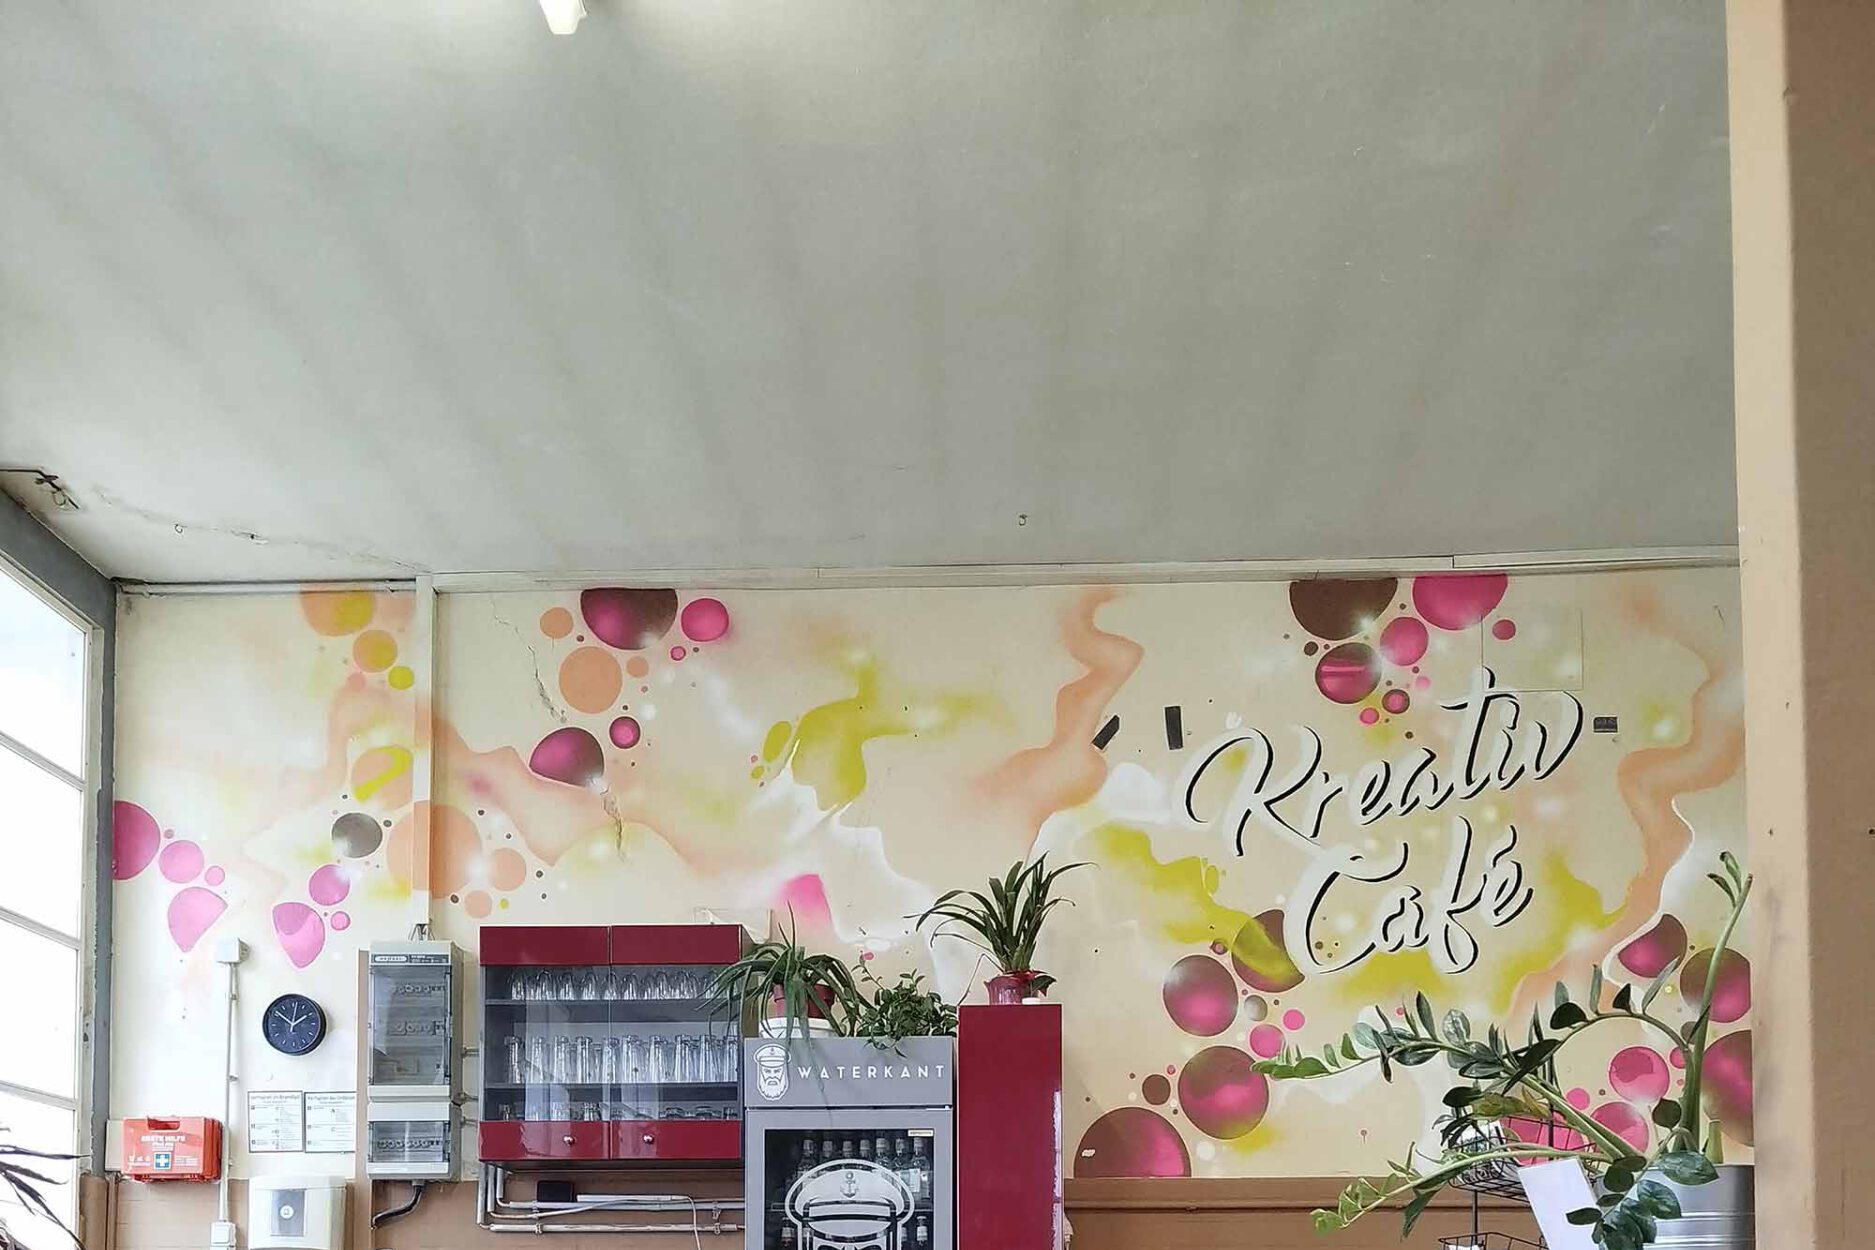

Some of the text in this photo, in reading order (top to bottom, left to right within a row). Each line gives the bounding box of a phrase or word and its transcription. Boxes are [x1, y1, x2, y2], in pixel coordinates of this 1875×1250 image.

[1180, 664, 1584, 856] Kreativ
[1292, 815, 1534, 974] Café
[797, 1064, 945, 1080] WATERKANT
